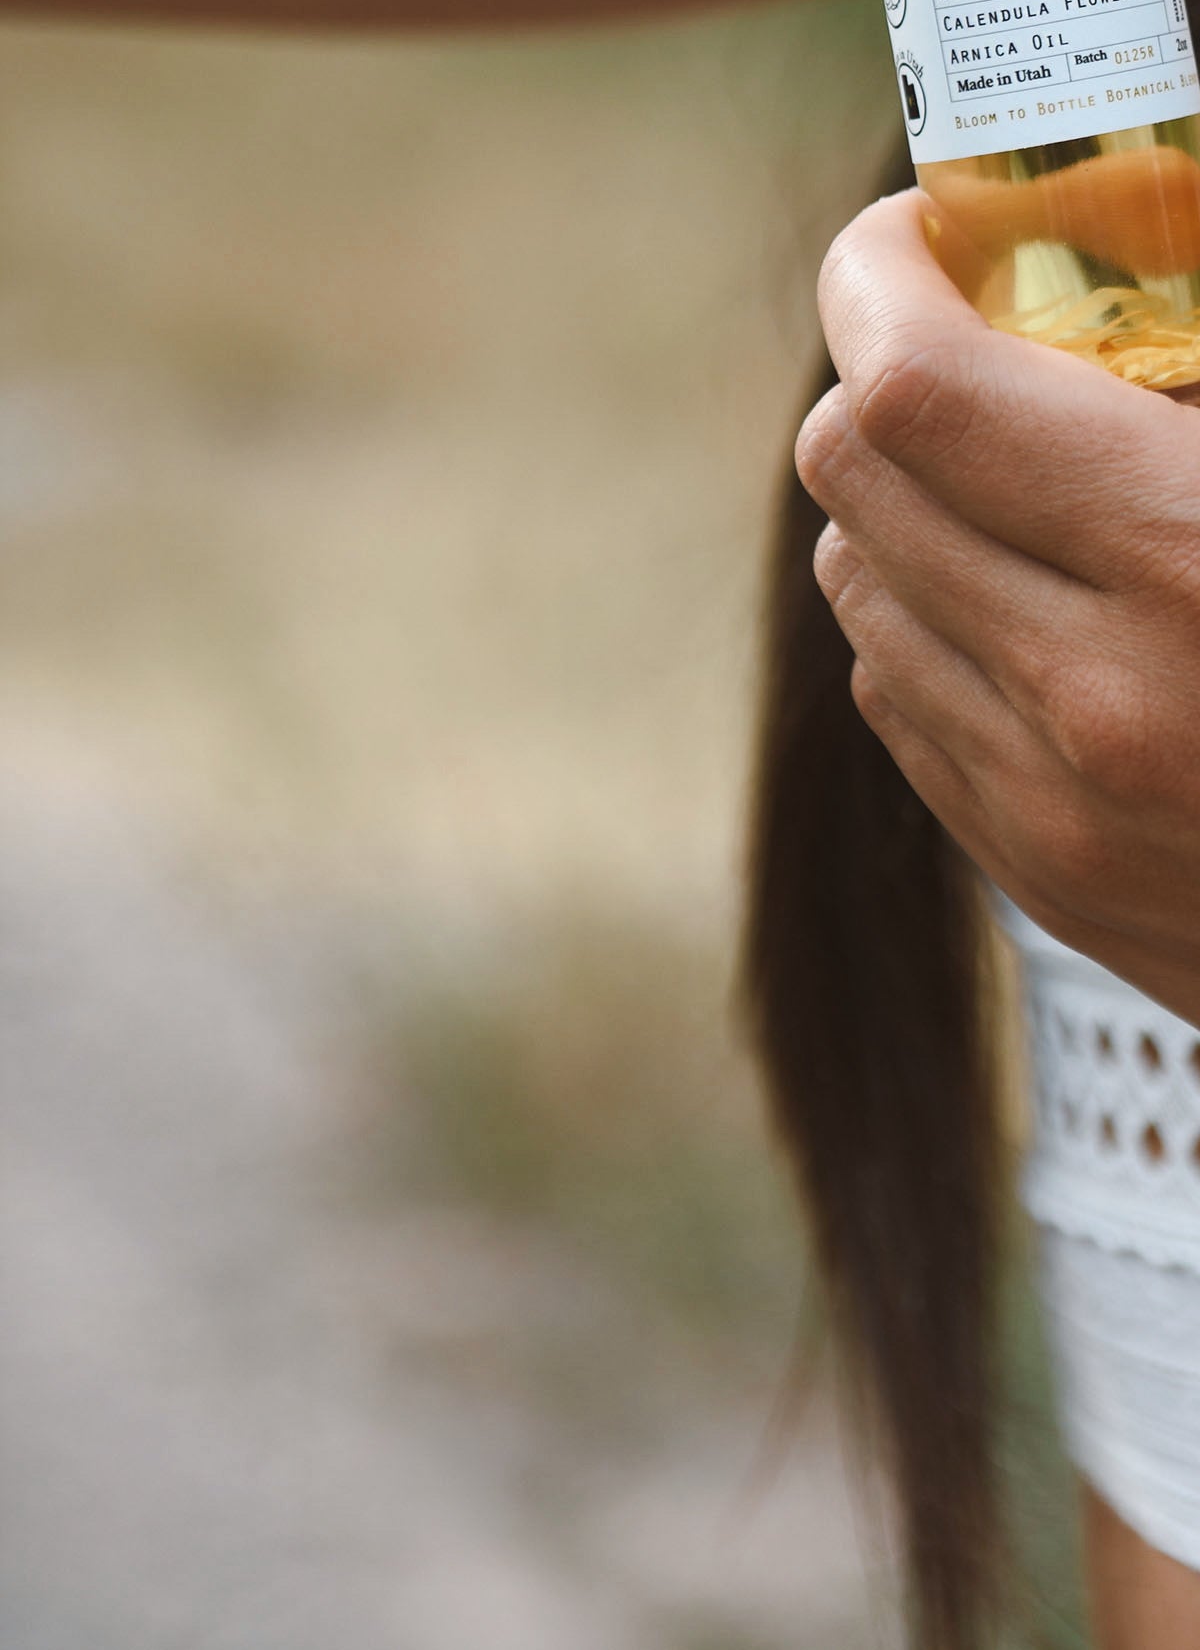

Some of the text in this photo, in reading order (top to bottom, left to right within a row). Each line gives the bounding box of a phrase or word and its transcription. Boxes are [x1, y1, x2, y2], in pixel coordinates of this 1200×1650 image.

[943, 2, 1050, 32] CALENDULA
[950, 33, 1069, 65] ARNICA OIL
[1074, 50, 1108, 65] Batch
[957, 65, 1052, 93] Made in Utah
[955, 113, 998, 129] BLOOM
[1008, 108, 1026, 120] TO
[1037, 95, 1096, 116] BOTTLE
[1105, 79, 1176, 103] BOTANICAL
